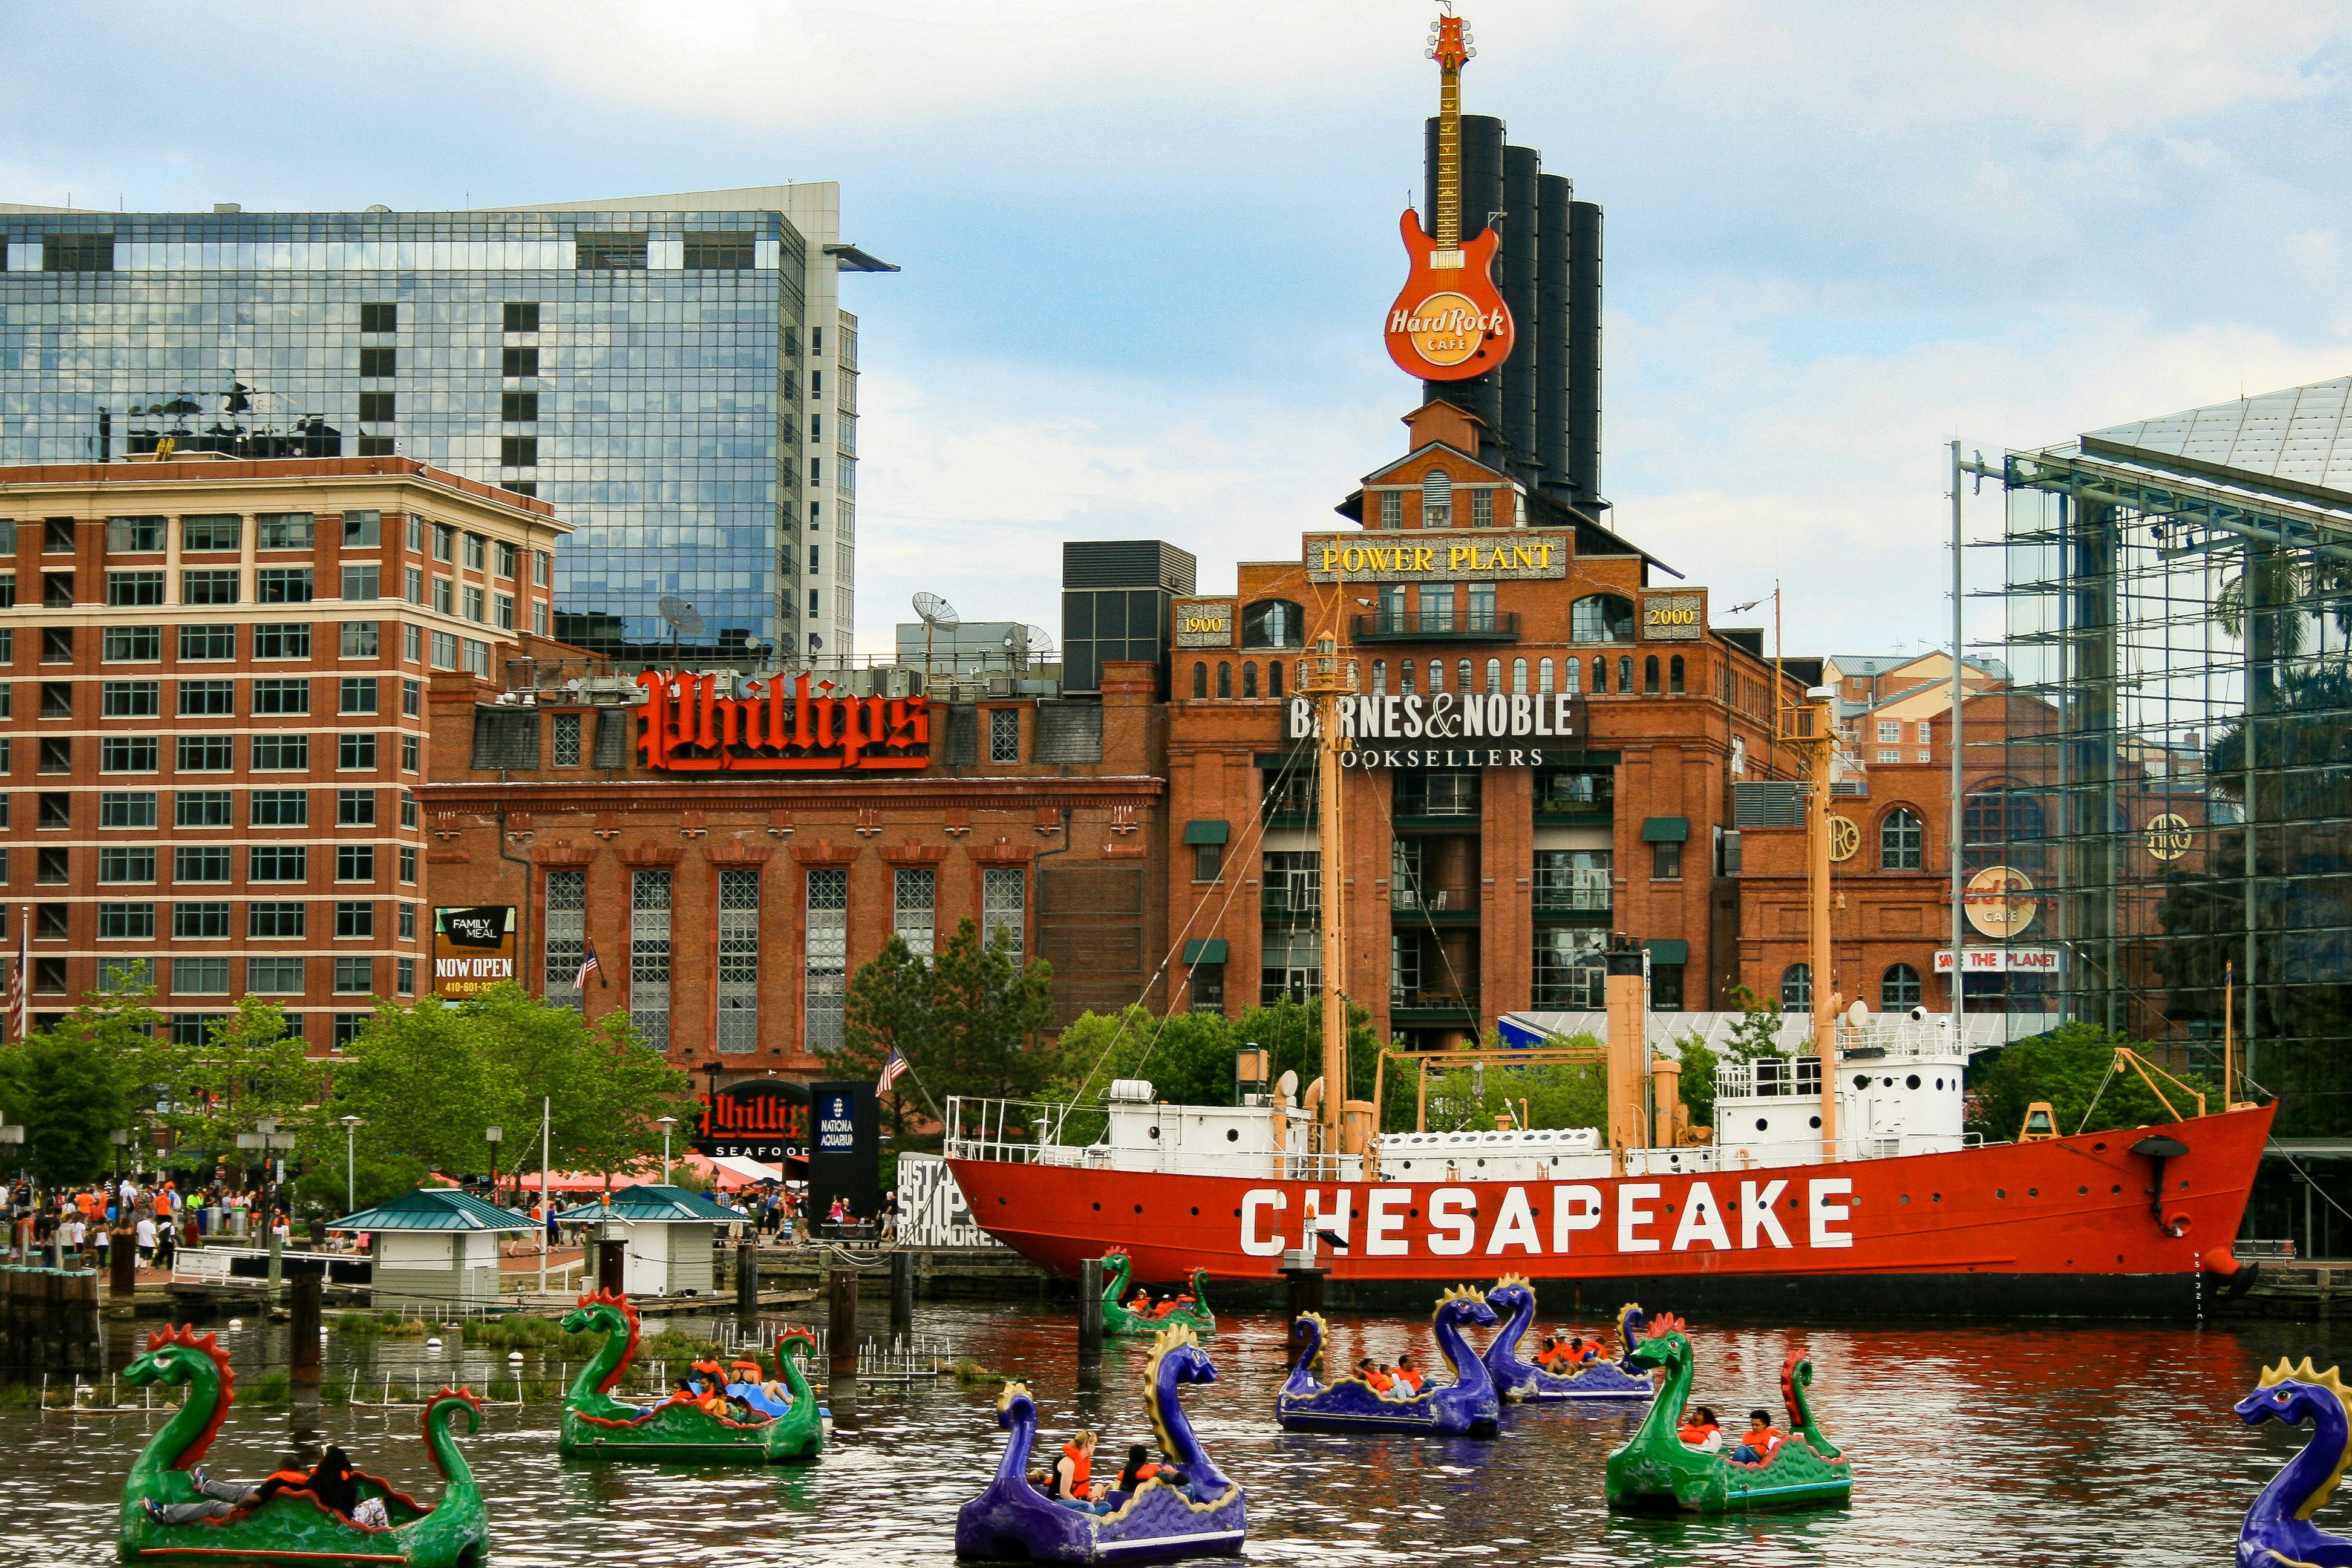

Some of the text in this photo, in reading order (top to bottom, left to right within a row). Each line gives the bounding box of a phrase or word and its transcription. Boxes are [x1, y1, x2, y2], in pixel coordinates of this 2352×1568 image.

[1391, 307, 1504, 336] Hard Rock
[1427, 339, 1467, 351] CAFE
[1322, 544, 1555, 572] POWER PLANT
[1185, 617, 1223, 633] 1900
[1649, 609, 1696, 625] 2000
[637, 669, 930, 769] Phillips
[1341, 749, 1543, 768] OOKSELLERS
[453, 919, 491, 929] FAMILY
[1984, 911, 2019, 922] CAFE
[466, 929, 497, 938] MEAL
[436, 958, 512, 977] NOW OPEN
[1938, 953, 2056, 968] SAV THE PLANET
[445, 982, 497, 992] 410-601-32
[699, 1093, 809, 1138] Phillip
[822, 1120, 853, 1132] NATIONA
[898, 1160, 956, 1186] HISTO
[1240, 1178, 1854, 1256] CHESAPEAKE
[897, 1223, 992, 1246] BALTIMORE
